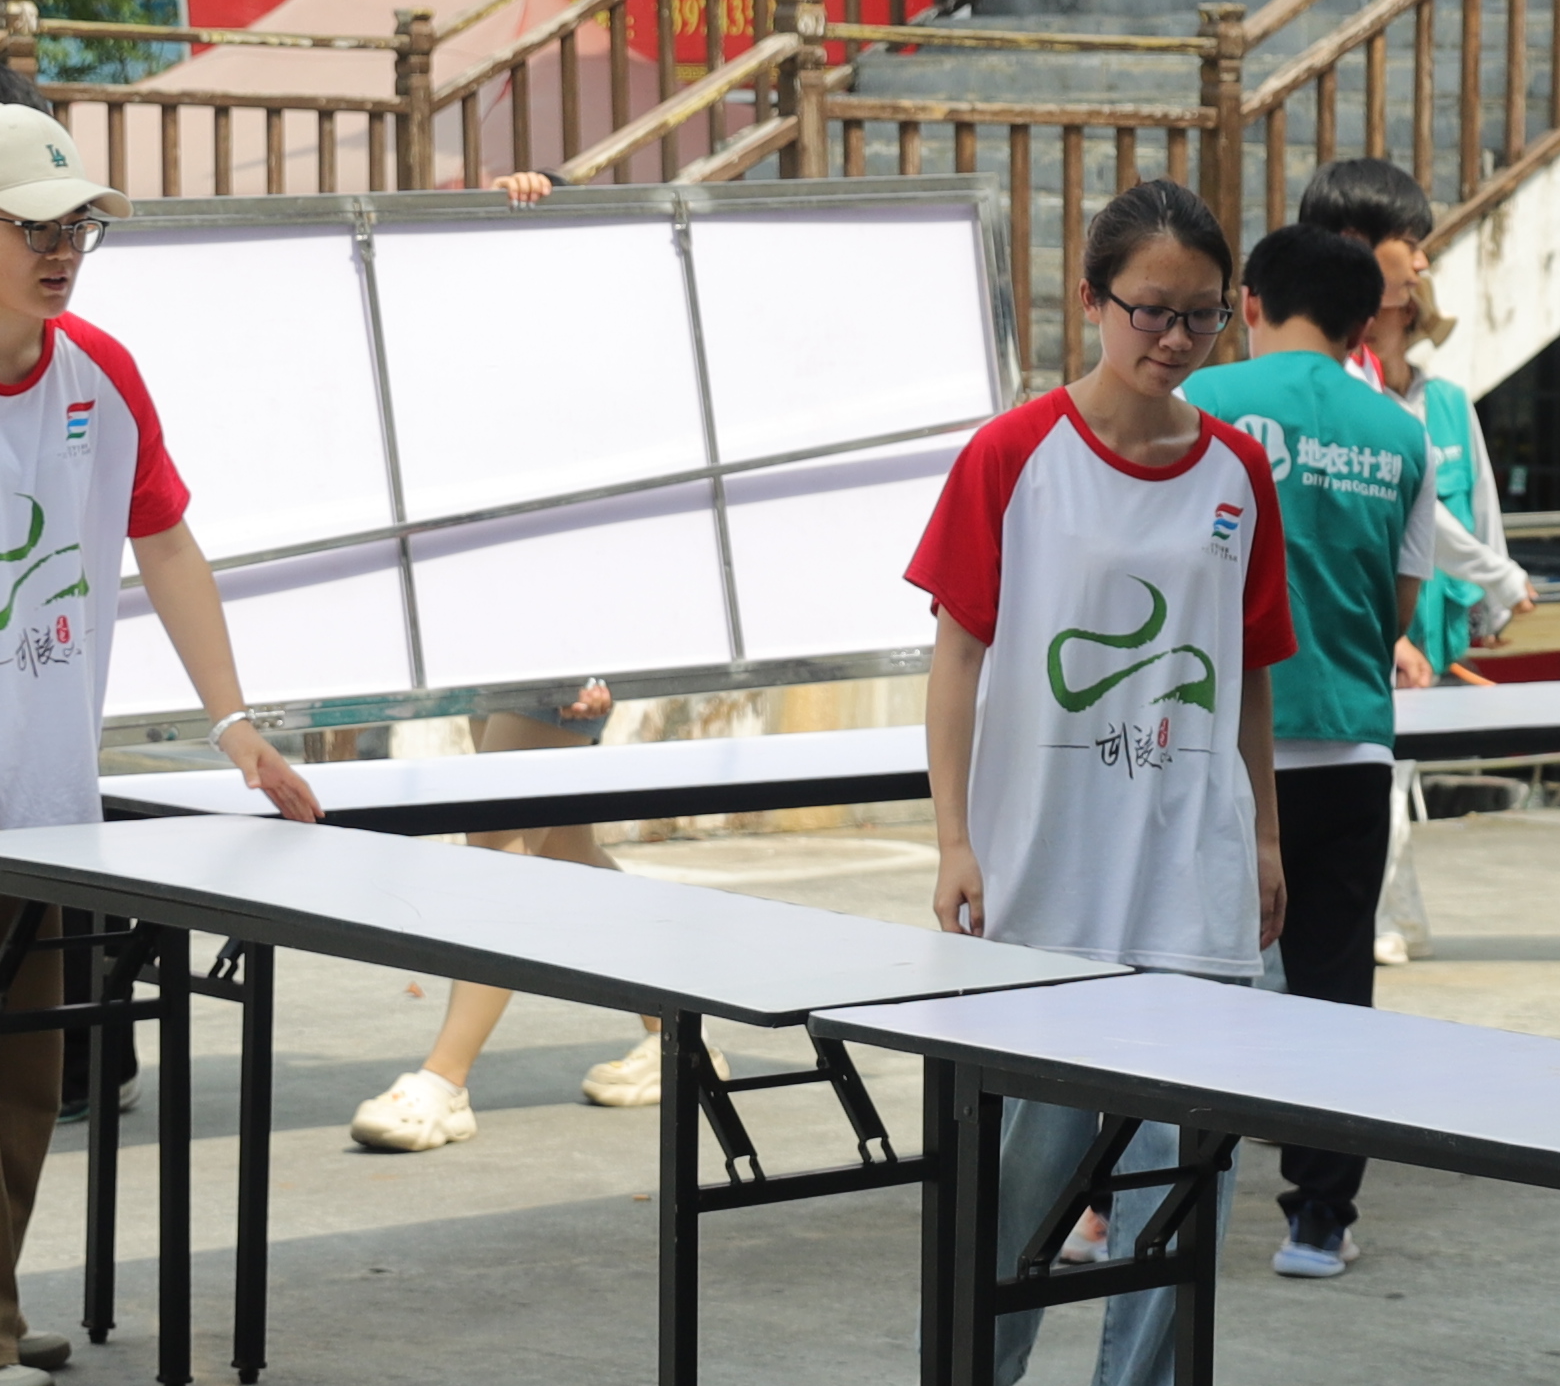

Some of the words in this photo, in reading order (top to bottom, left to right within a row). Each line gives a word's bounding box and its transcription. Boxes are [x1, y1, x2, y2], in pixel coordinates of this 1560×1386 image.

[1297, 435, 1402, 484] 地衣计划
[1332, 479, 1397, 501] PROGRAM
